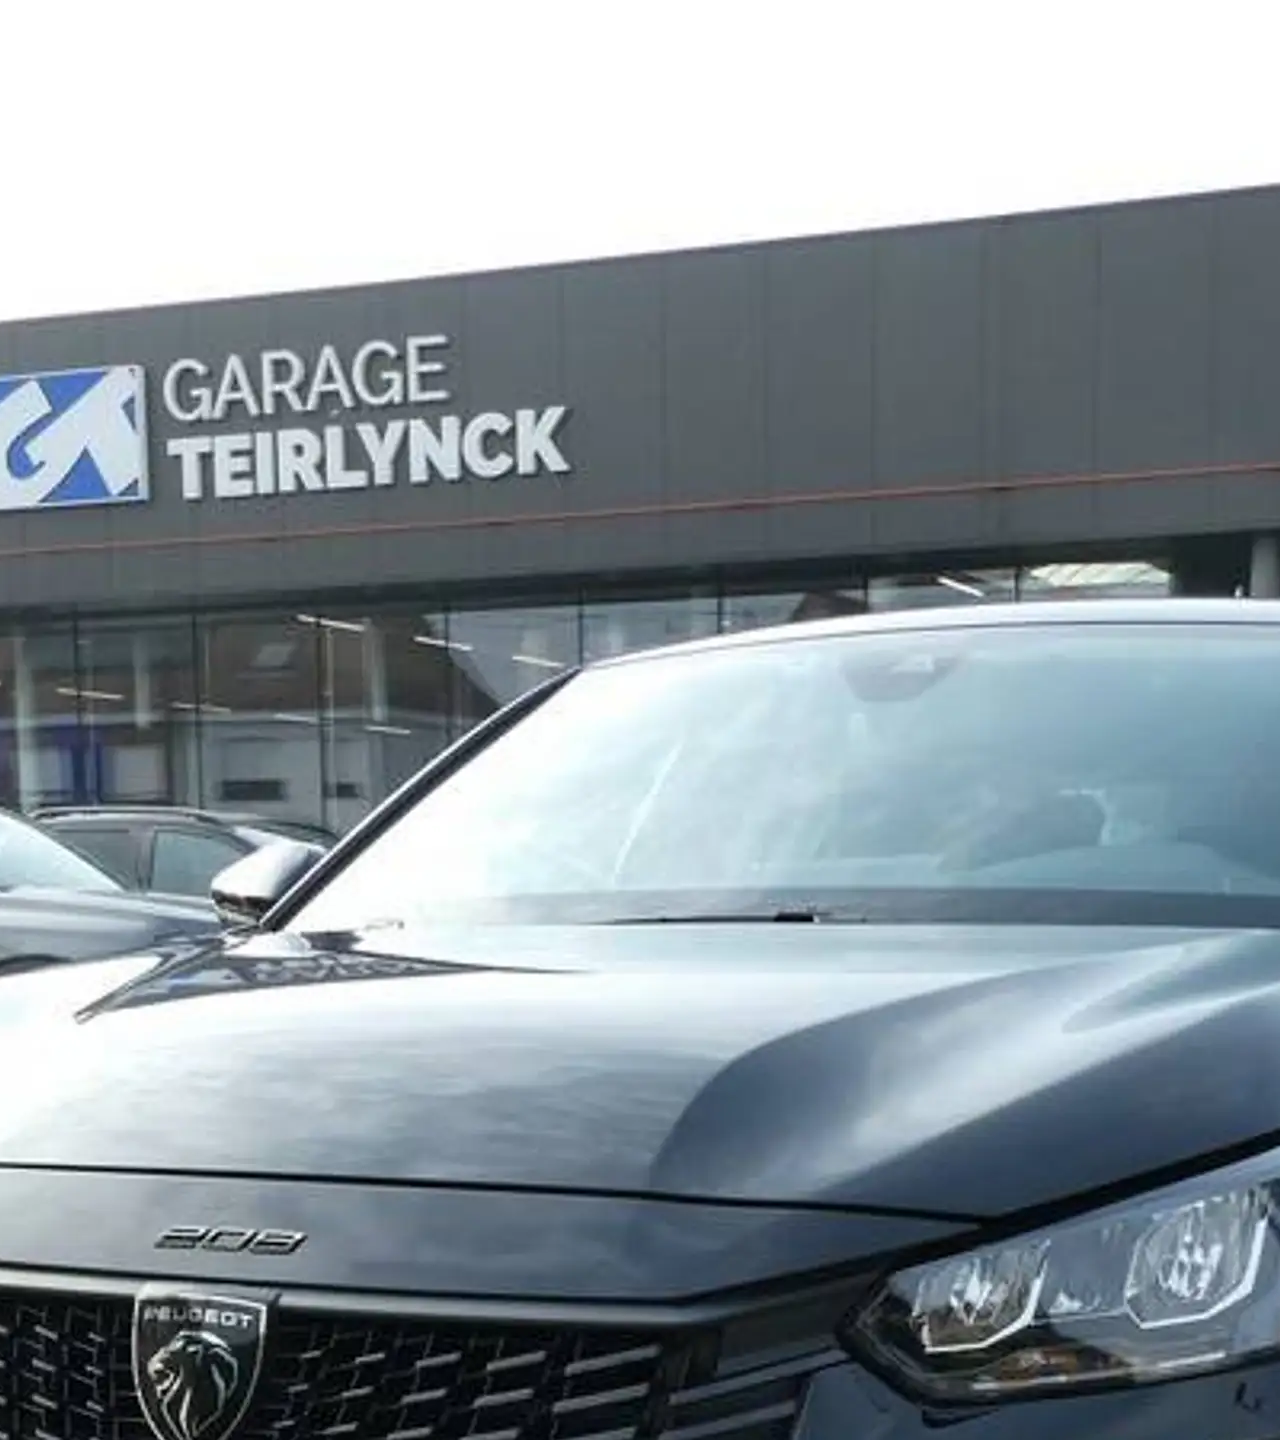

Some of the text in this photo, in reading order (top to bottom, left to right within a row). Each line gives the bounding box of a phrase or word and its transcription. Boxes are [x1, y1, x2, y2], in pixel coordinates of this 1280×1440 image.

[163, 334, 449, 422] GARAGE
[166, 405, 570, 501] TEIRLYNCK
[153, 1224, 308, 1255] 208
[143, 1305, 254, 1329] PEUGEOT
